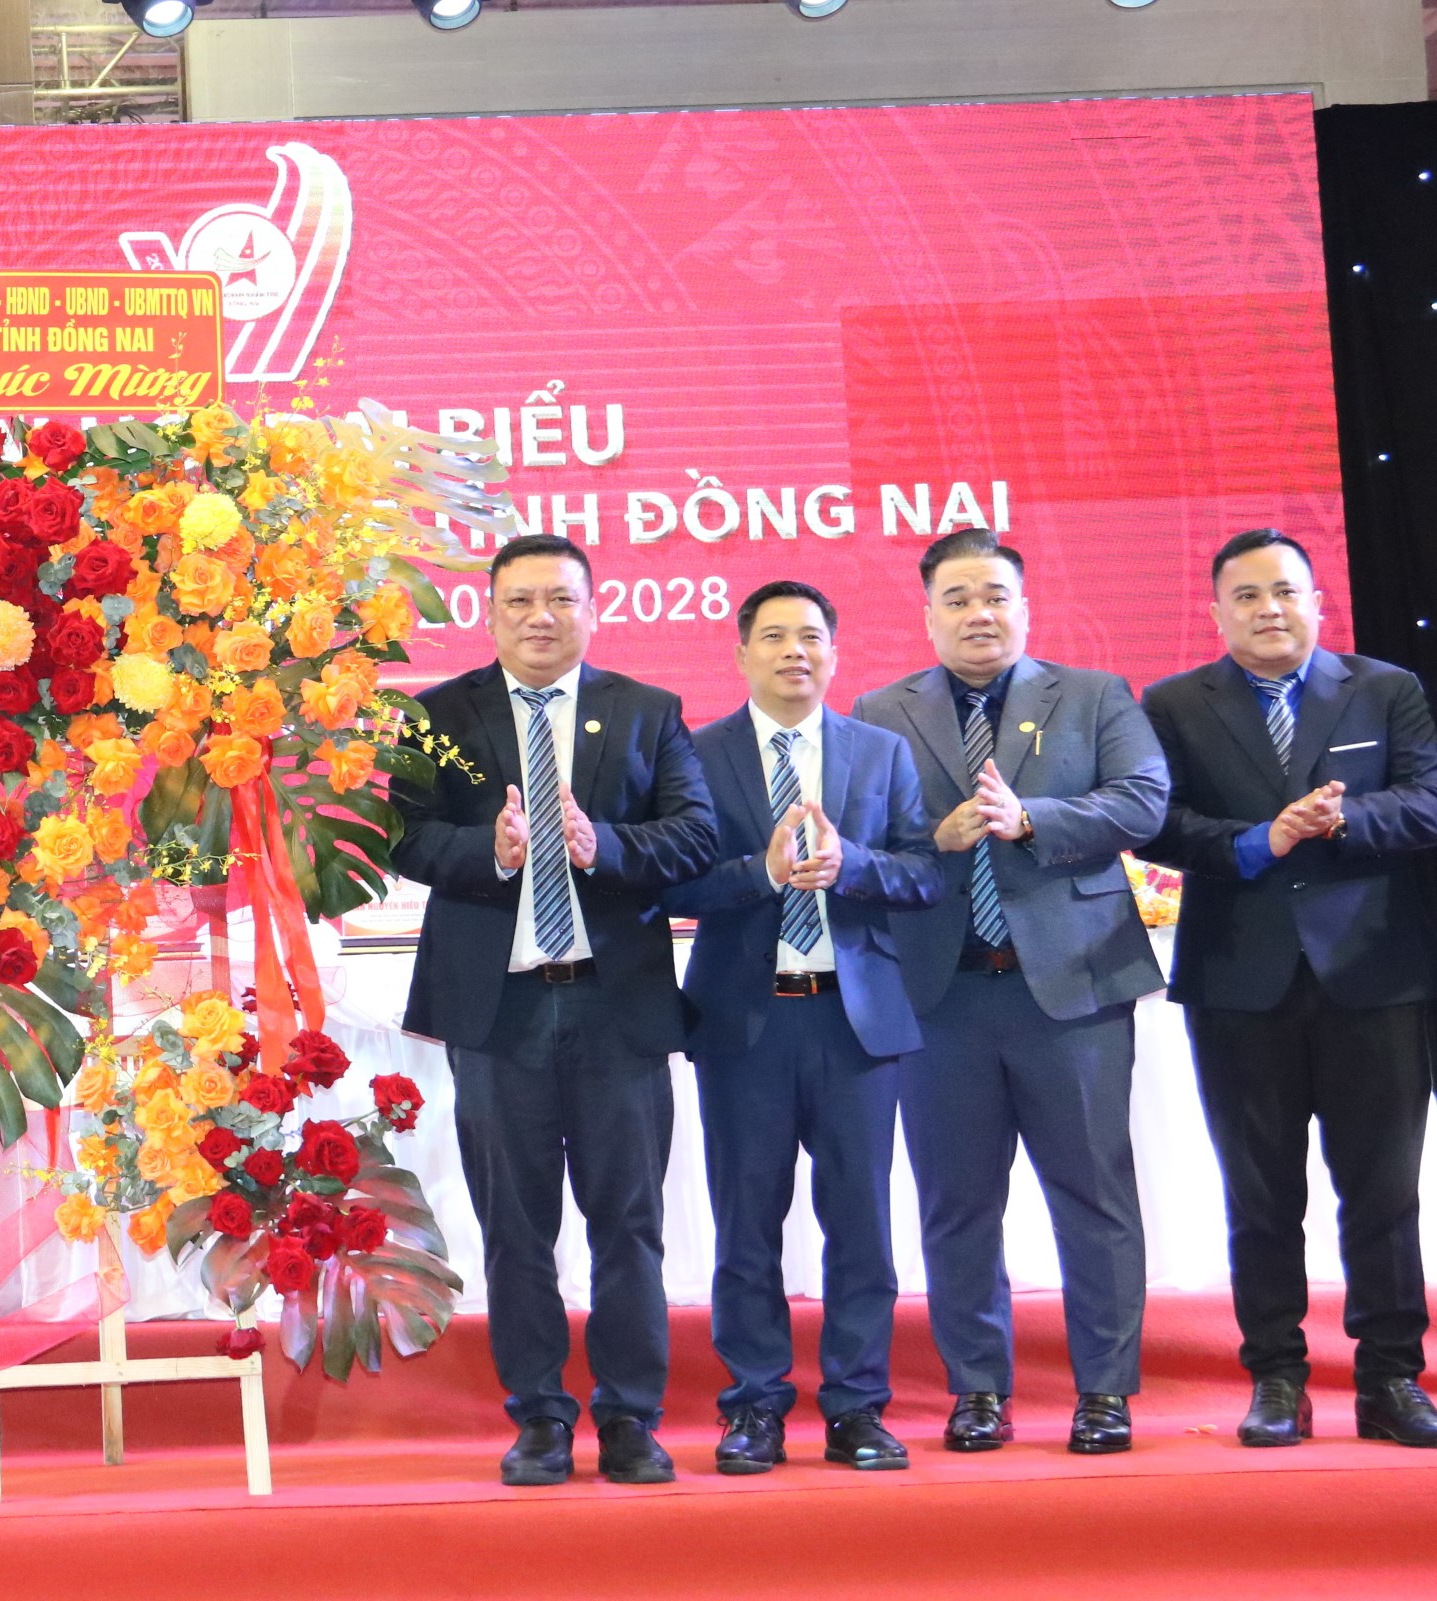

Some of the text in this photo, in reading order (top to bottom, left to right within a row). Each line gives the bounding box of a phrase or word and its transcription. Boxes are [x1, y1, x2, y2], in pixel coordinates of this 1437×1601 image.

[6, 287, 50, 315] HĐND
[65, 287, 109, 316] UBND
[124, 288, 188, 319] UBMTTQ
[192, 289, 214, 316] VN
[47, 318, 109, 352] ĐỒNG
[115, 327, 154, 352] NAI
[624, 468, 855, 545] ĐỒNG
[879, 480, 1011, 537] NAI
[598, 575, 731, 623] 2028
